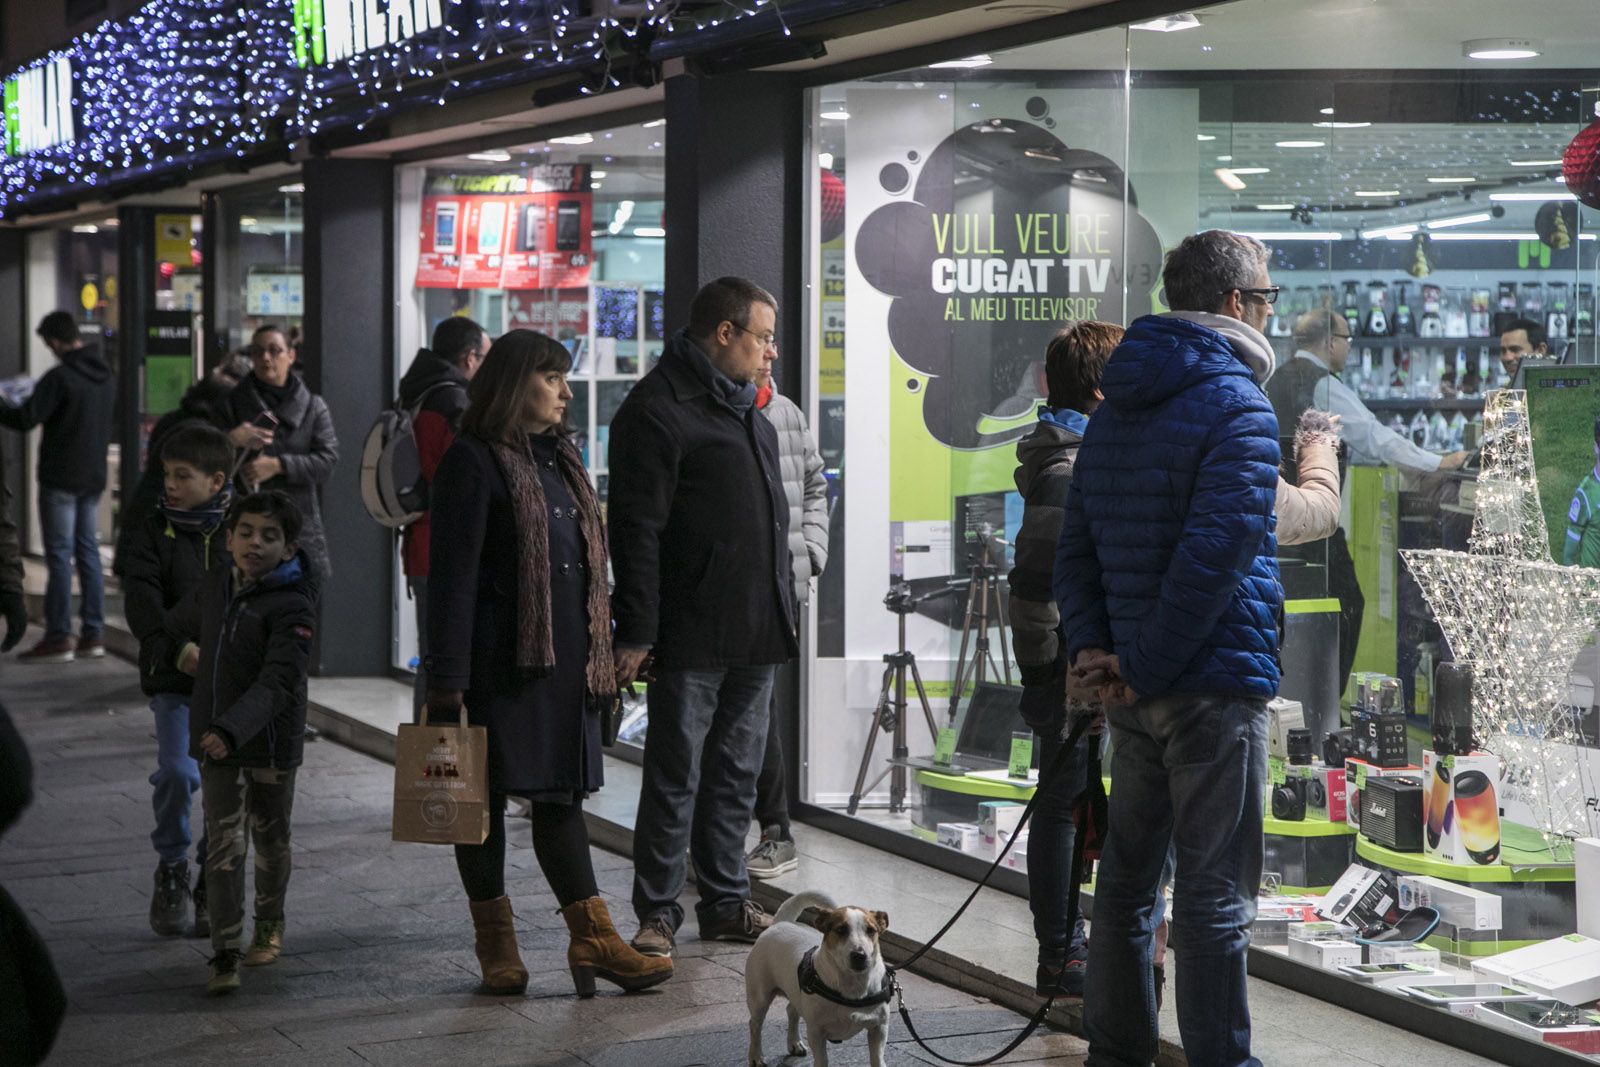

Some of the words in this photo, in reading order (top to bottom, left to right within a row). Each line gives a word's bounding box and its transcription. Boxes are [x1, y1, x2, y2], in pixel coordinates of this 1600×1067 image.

[323, 0, 443, 63] MILA
[932, 213, 1004, 254] VULL
[1015, 213, 1111, 254] VEURE
[932, 258, 1054, 294] CUGAT
[1062, 258, 1112, 294] TV
[944, 298, 965, 321] AL
[971, 298, 1007, 321] MEU
[1369, 723, 1377, 737] 6
